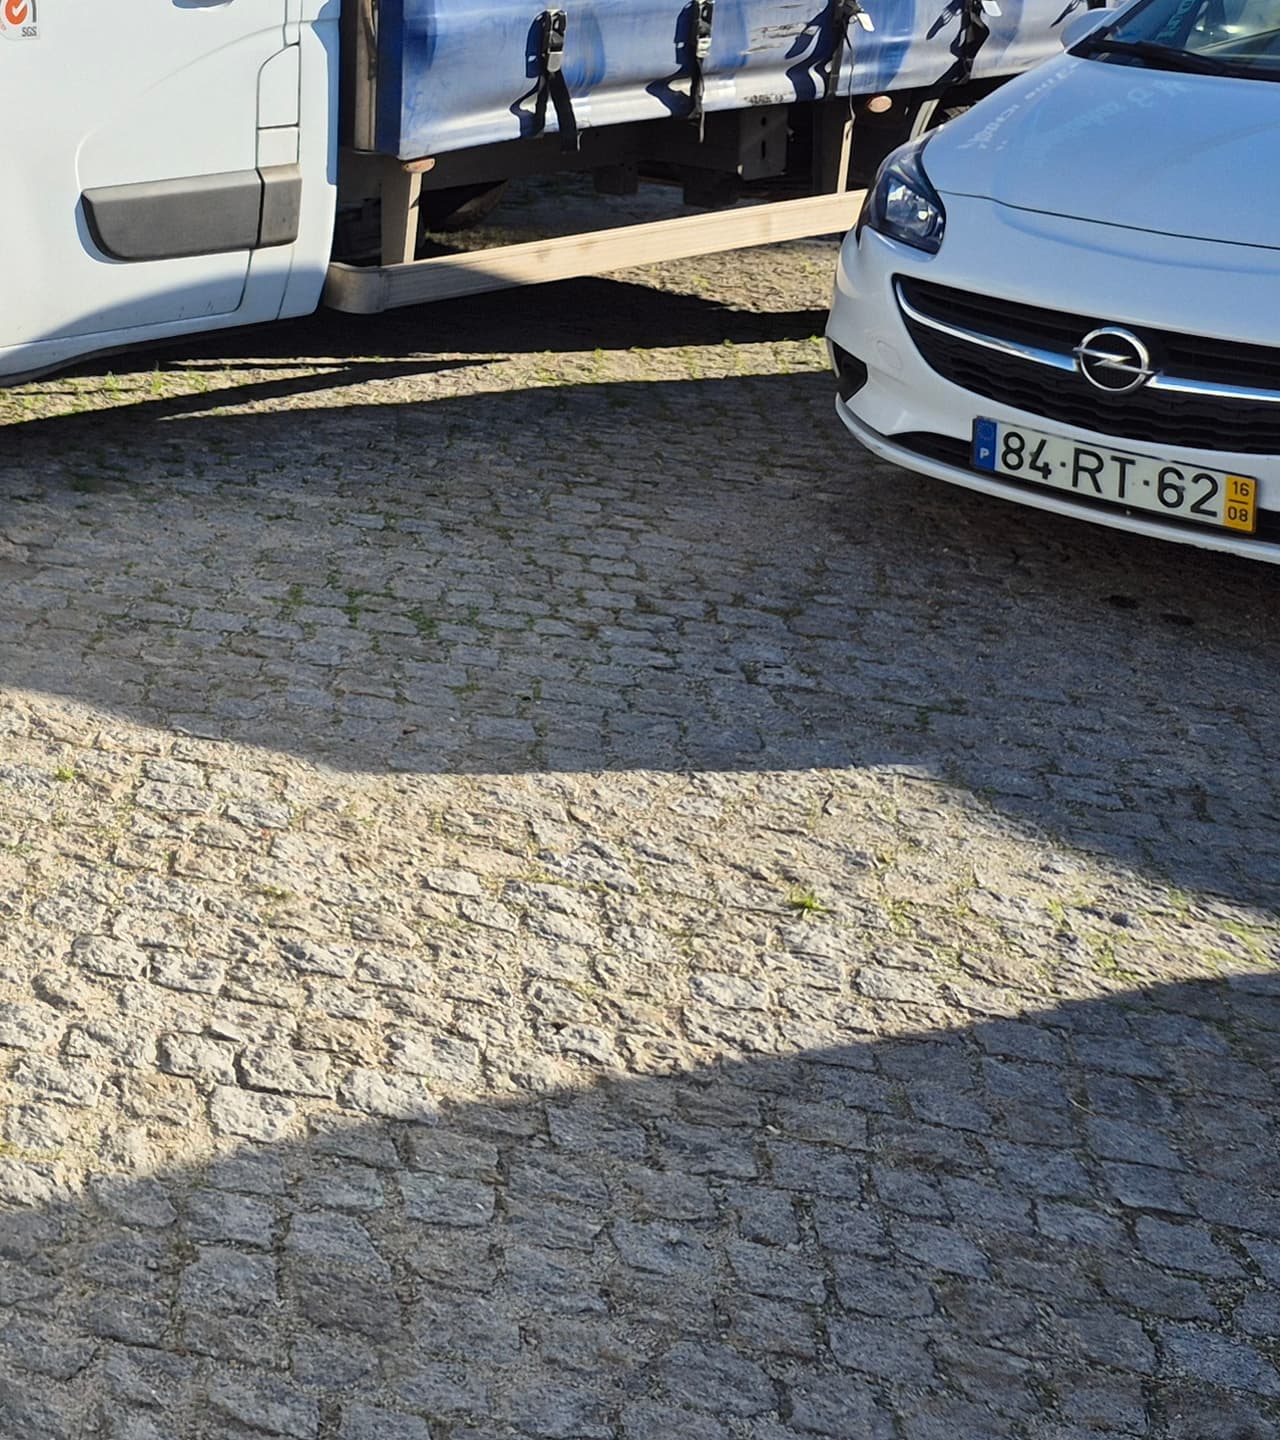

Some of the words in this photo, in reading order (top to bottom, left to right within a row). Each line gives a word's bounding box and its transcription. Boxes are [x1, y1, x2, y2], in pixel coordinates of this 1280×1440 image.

[21, 25, 37, 37] SGS
[979, 447, 990, 459] P
[1232, 480, 1250, 497] 16
[1227, 506, 1249, 522] 08
